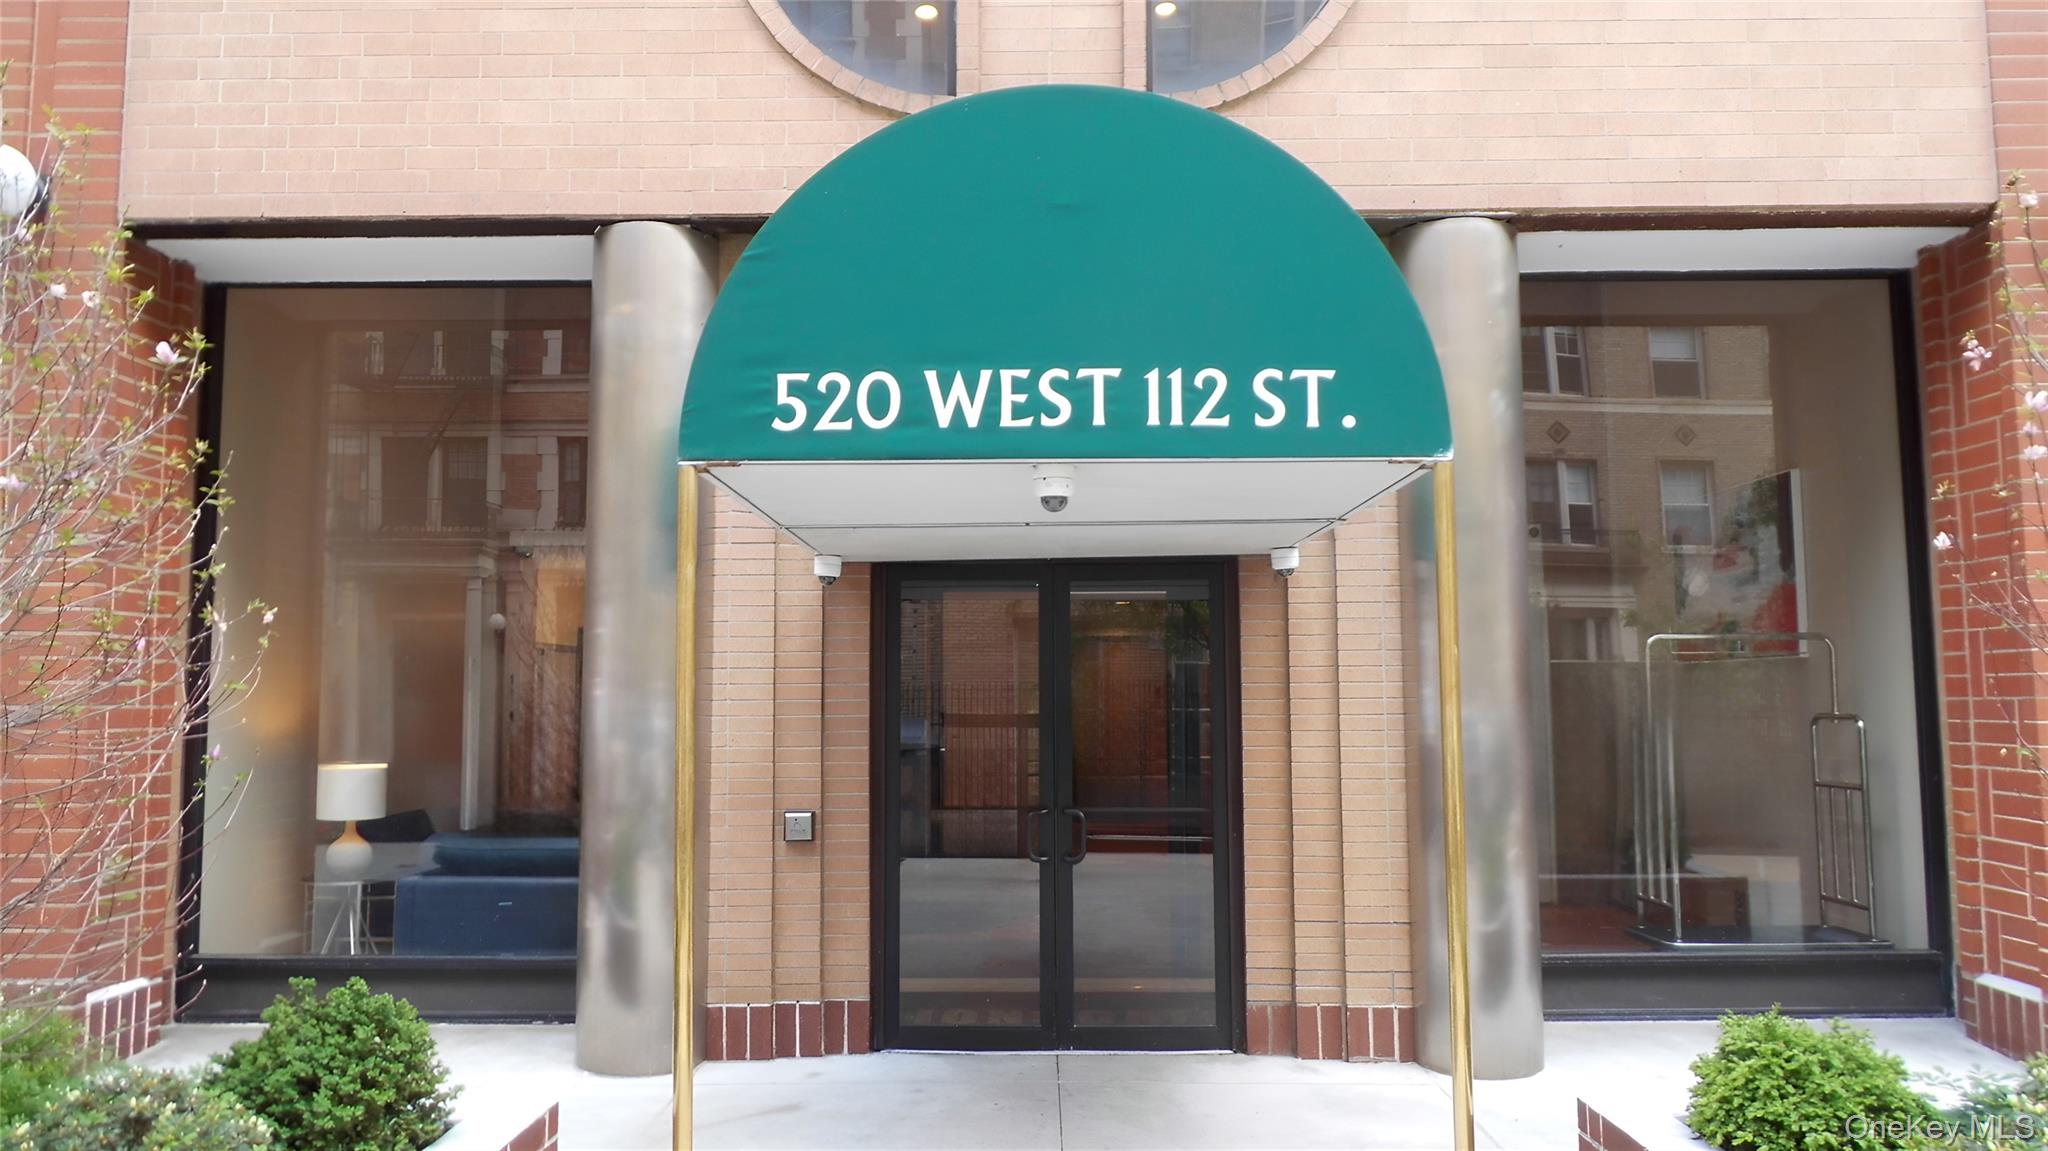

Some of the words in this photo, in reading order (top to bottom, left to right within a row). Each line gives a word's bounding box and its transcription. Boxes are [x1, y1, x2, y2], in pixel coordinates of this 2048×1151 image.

[772, 371, 902, 432] 520
[923, 367, 1121, 429] WEST
[1144, 367, 1230, 427] 112
[1252, 367, 1357, 429] ST.
